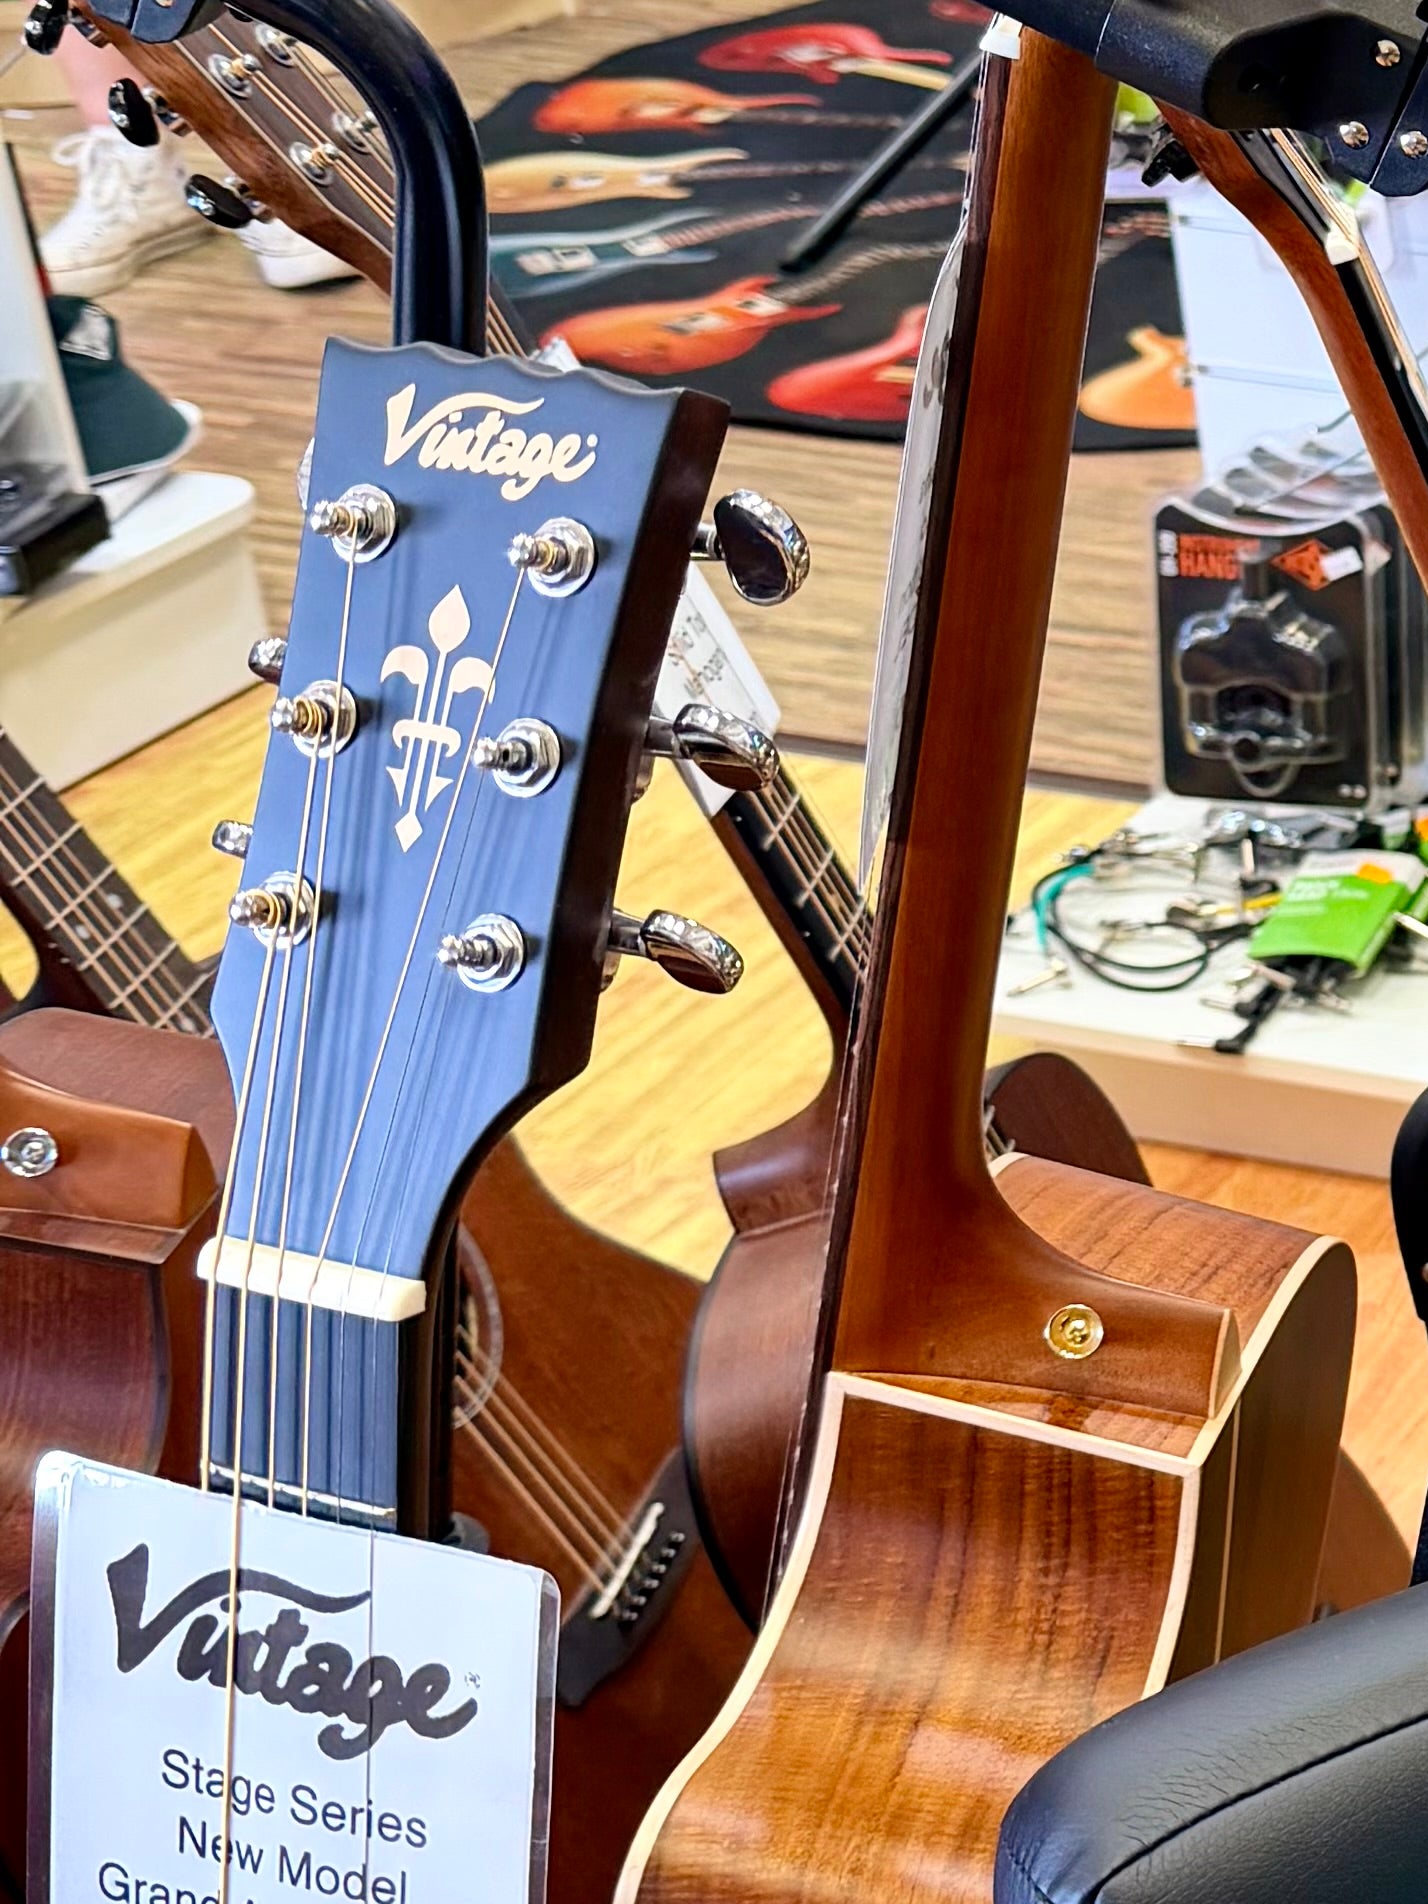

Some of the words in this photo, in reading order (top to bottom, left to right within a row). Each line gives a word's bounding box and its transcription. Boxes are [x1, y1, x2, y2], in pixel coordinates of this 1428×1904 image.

[383, 383, 598, 502] Vintage
[106, 1544, 477, 1760] Vintage
[162, 1749, 276, 1816] Stage
[290, 1783, 428, 1849] Series
[179, 1815, 264, 1876] New
